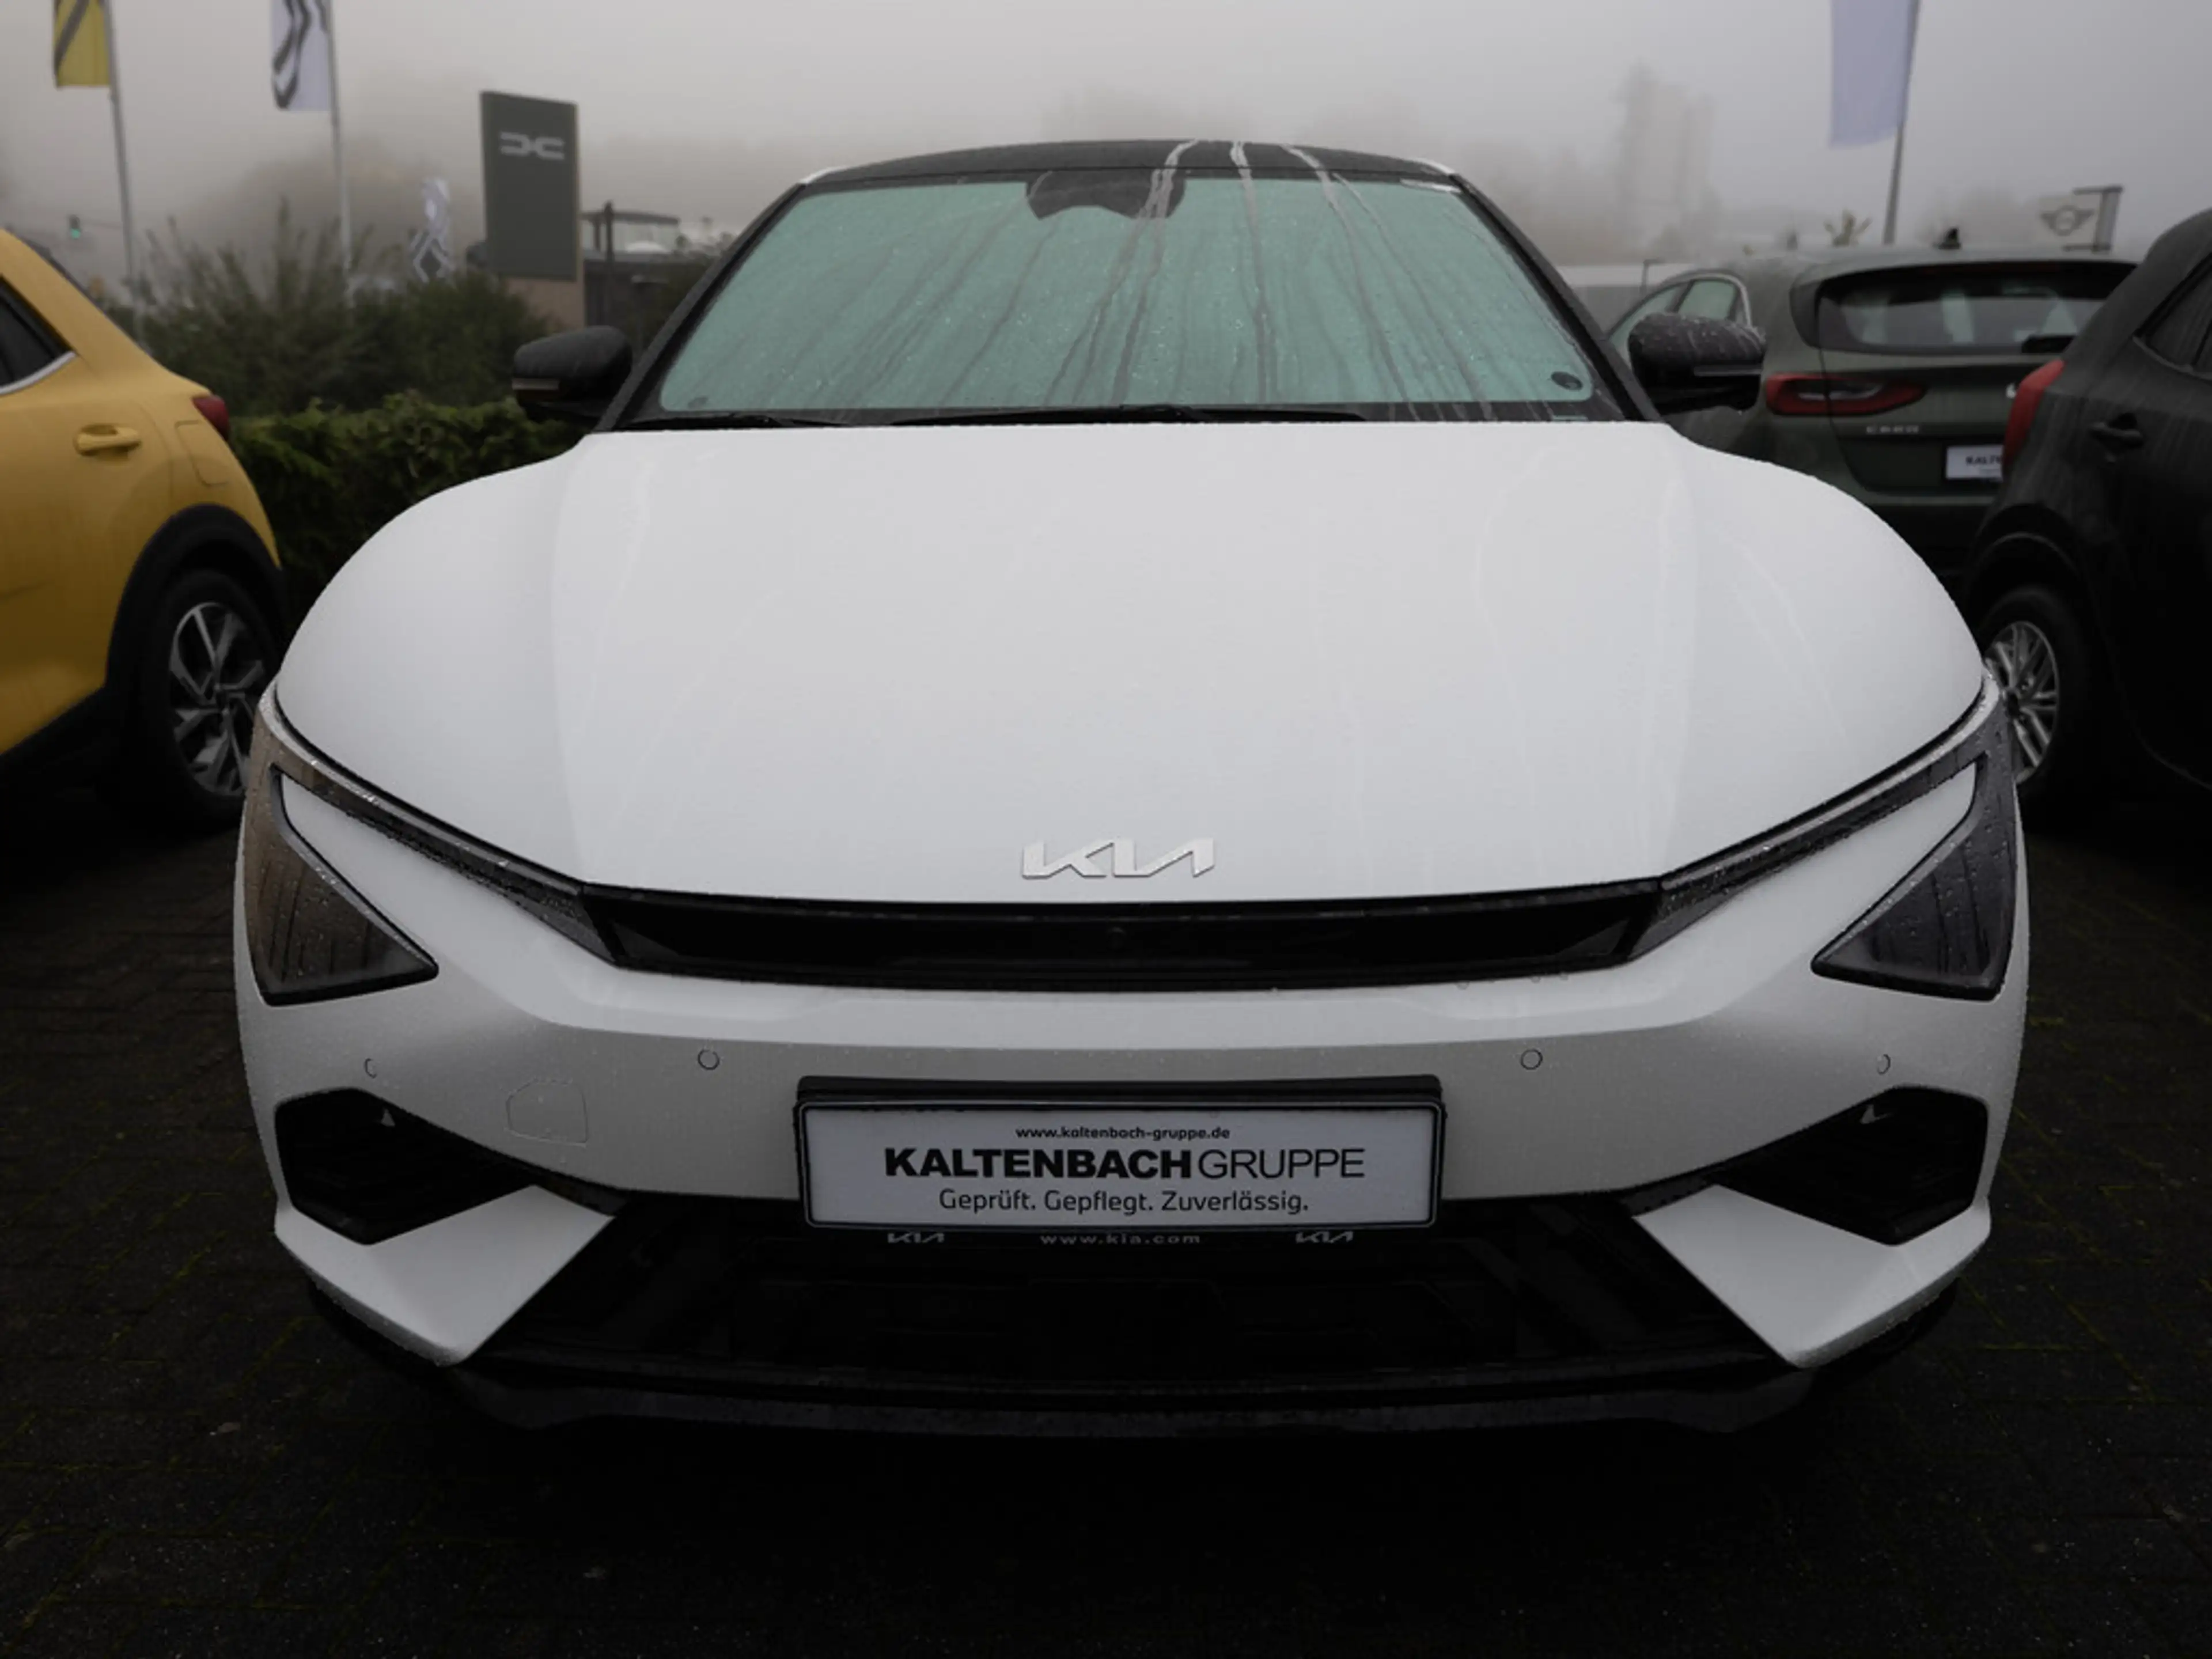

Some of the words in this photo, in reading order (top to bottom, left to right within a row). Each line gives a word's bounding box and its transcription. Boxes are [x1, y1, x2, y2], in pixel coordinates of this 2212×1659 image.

[1022, 838, 1215, 879] KIA
[1015, 1126, 1230, 1141] www.kaltenbach-gruppe.de
[938, 1188, 1036, 1214] Geprüft.
[1043, 1189, 1153, 1216] Gepflegt.
[1161, 1190, 1309, 1215] Zuverlässig.
[887, 1232, 945, 1244] KIA
[1039, 1232, 1200, 1245] www.kia.com
[1295, 1230, 1354, 1244] KIA
